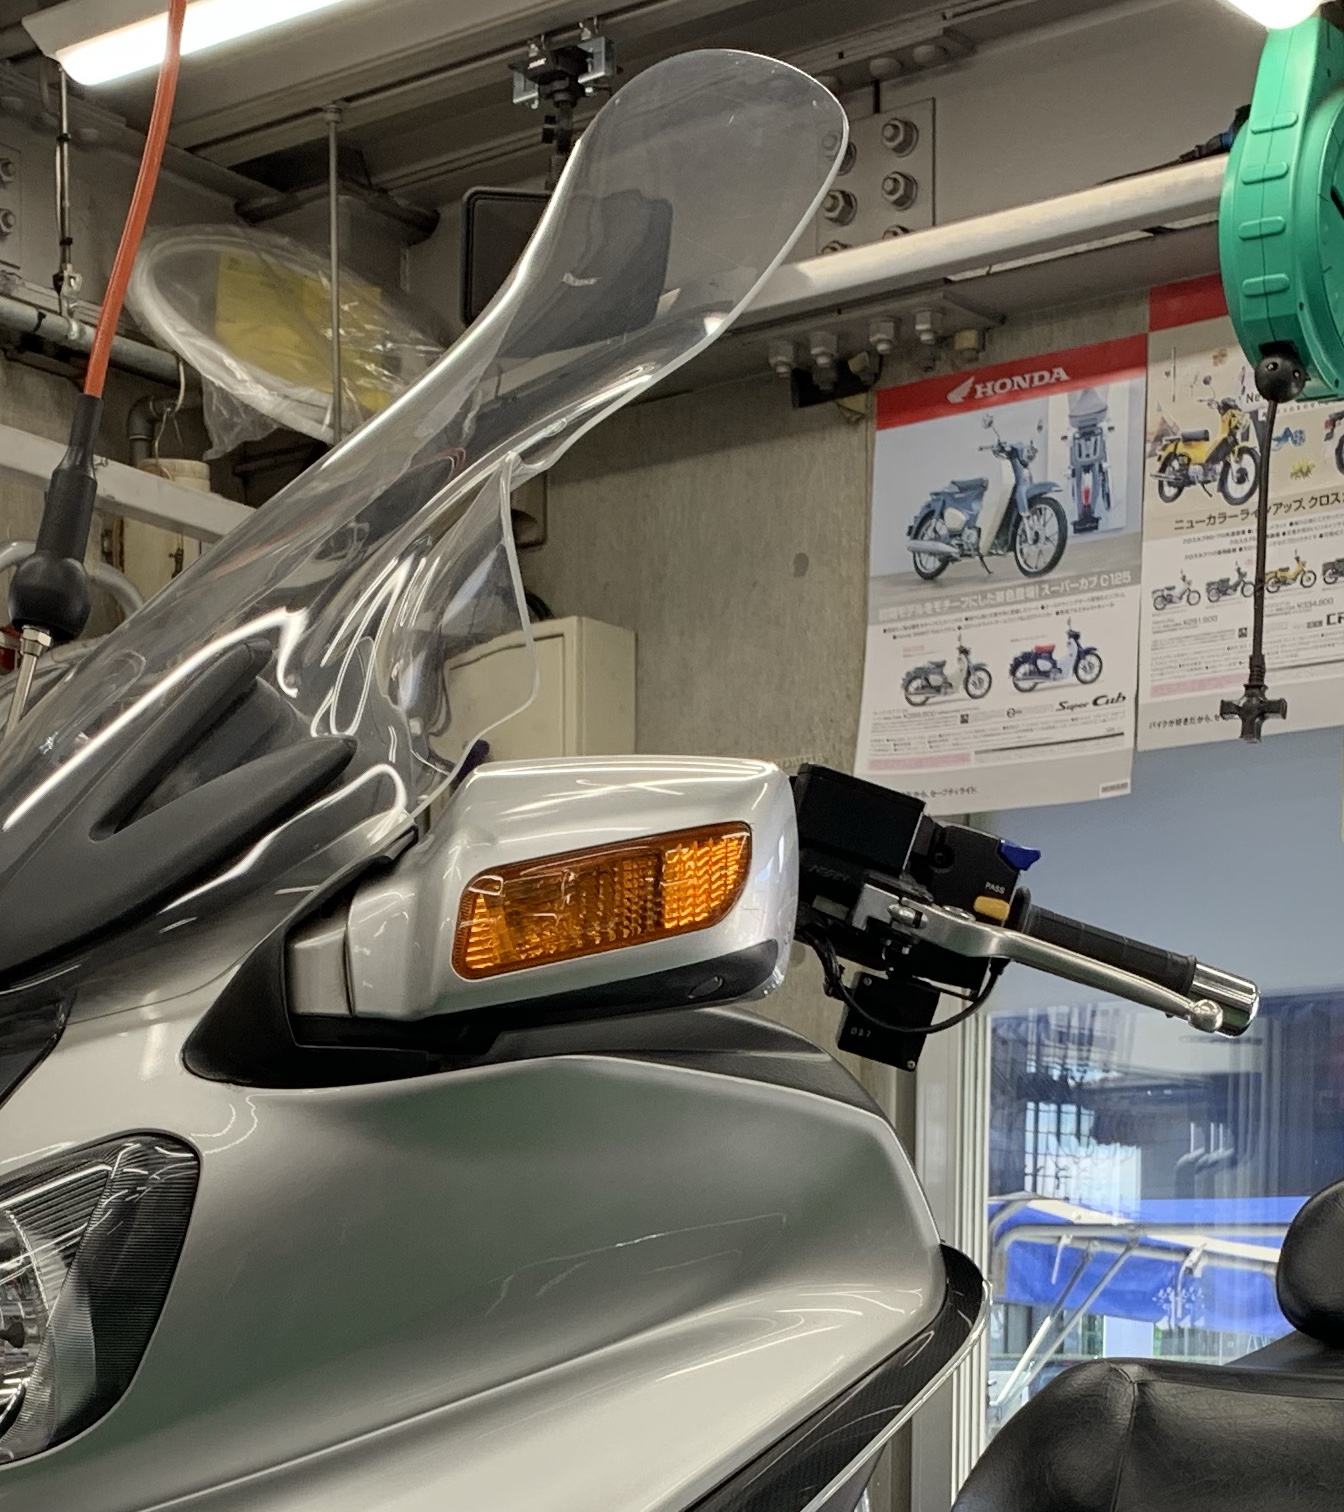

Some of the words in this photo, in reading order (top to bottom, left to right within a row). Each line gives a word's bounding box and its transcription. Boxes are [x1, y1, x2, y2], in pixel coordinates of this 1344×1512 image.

[974, 366, 1071, 400] HONDA
[1100, 571, 1132, 587] C125
[1056, 700, 1090, 712] Super
[1092, 692, 1127, 707] Cub
[985, 881, 1006, 895] PASS
